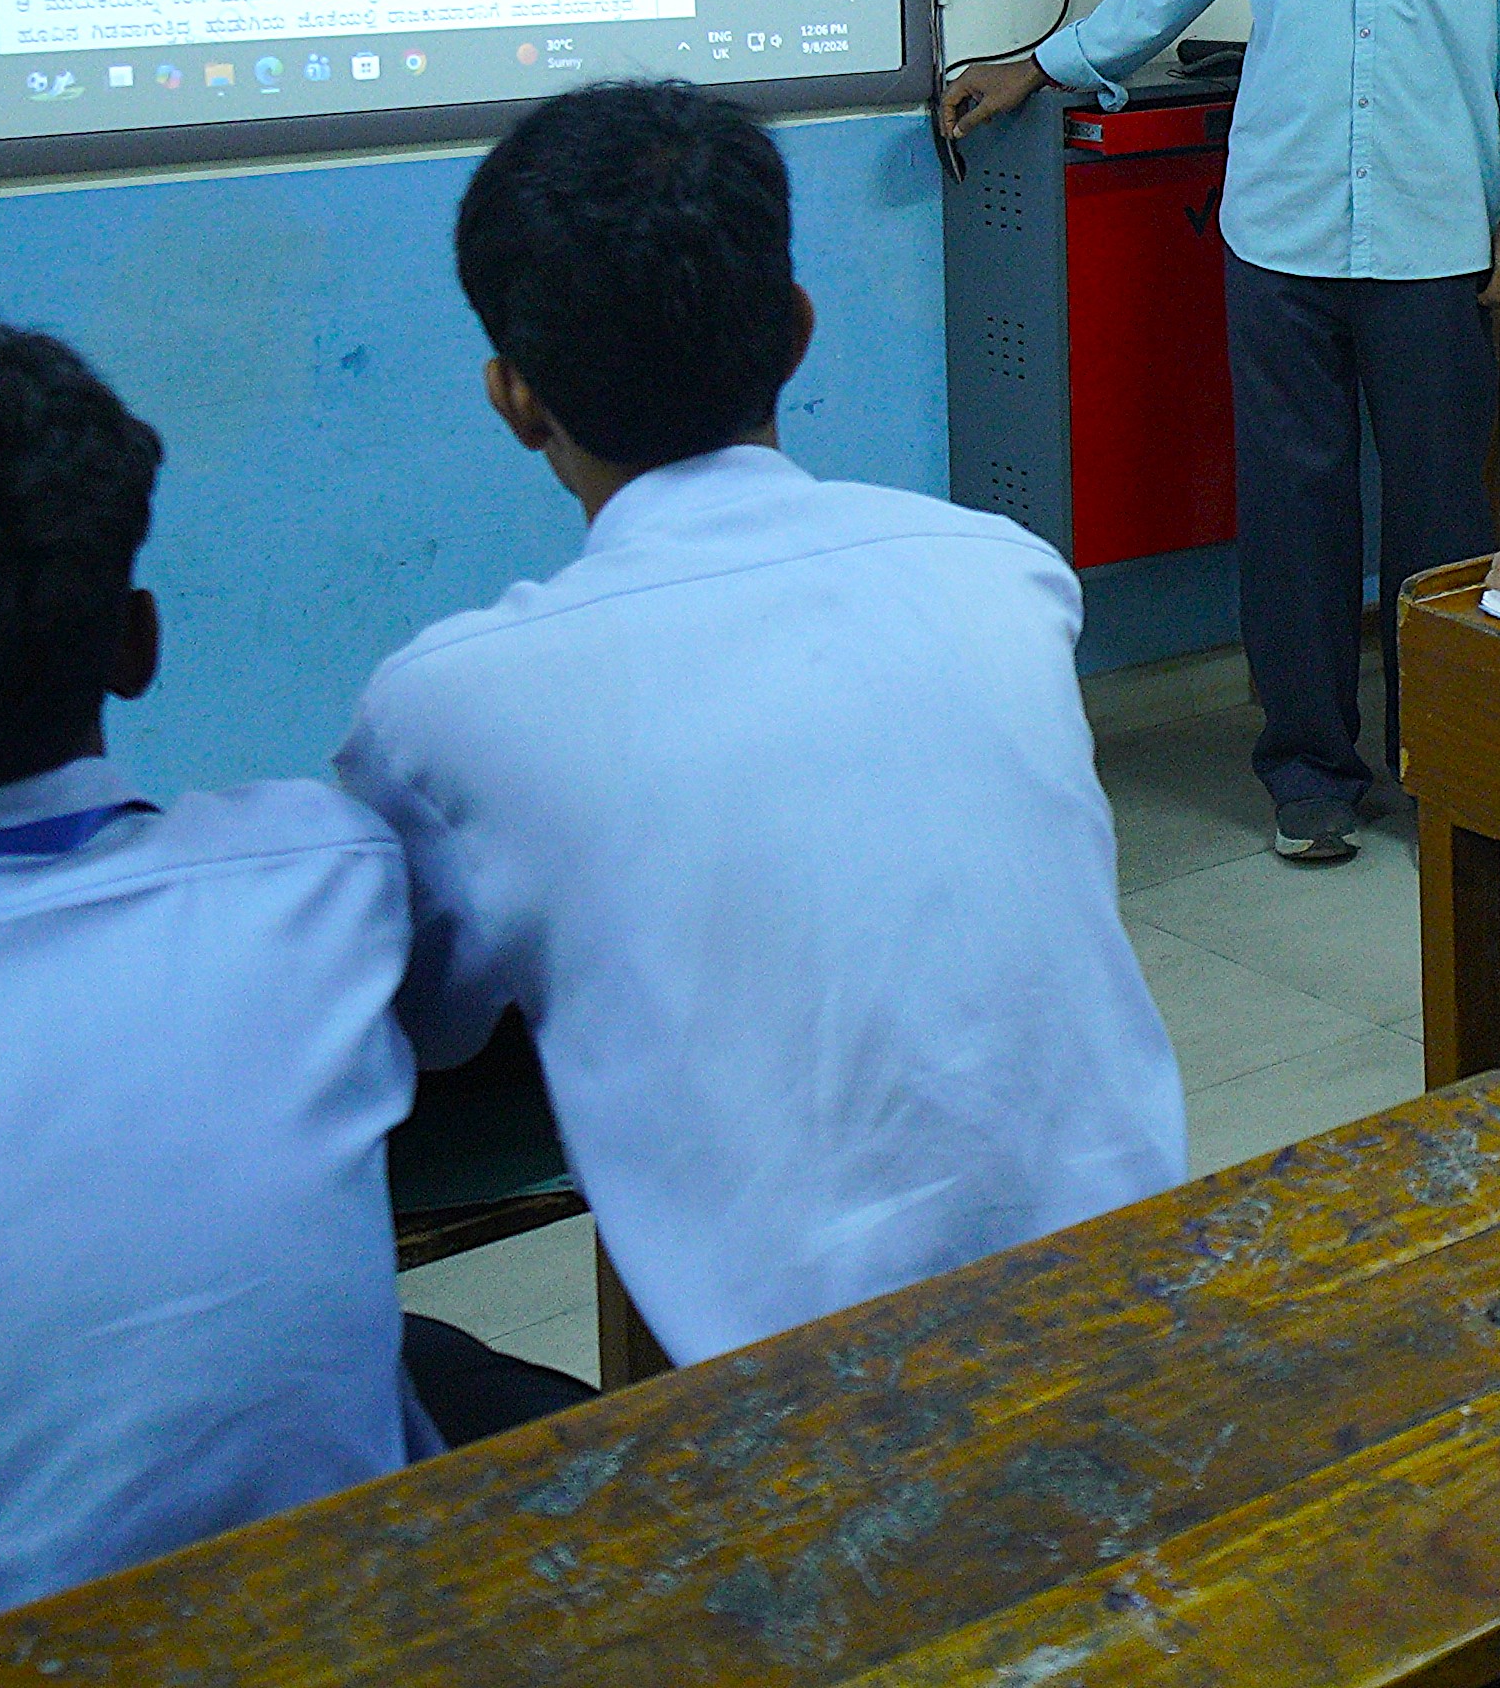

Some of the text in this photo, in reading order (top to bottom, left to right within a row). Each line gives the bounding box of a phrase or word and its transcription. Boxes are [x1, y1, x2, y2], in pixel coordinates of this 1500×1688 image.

[708, 29, 733, 44] ENG
[800, 22, 848, 37] 12:06 PM
[545, 38, 575, 53] 30°C
[712, 46, 731, 61] UK
[546, 55, 584, 72] Sunny
